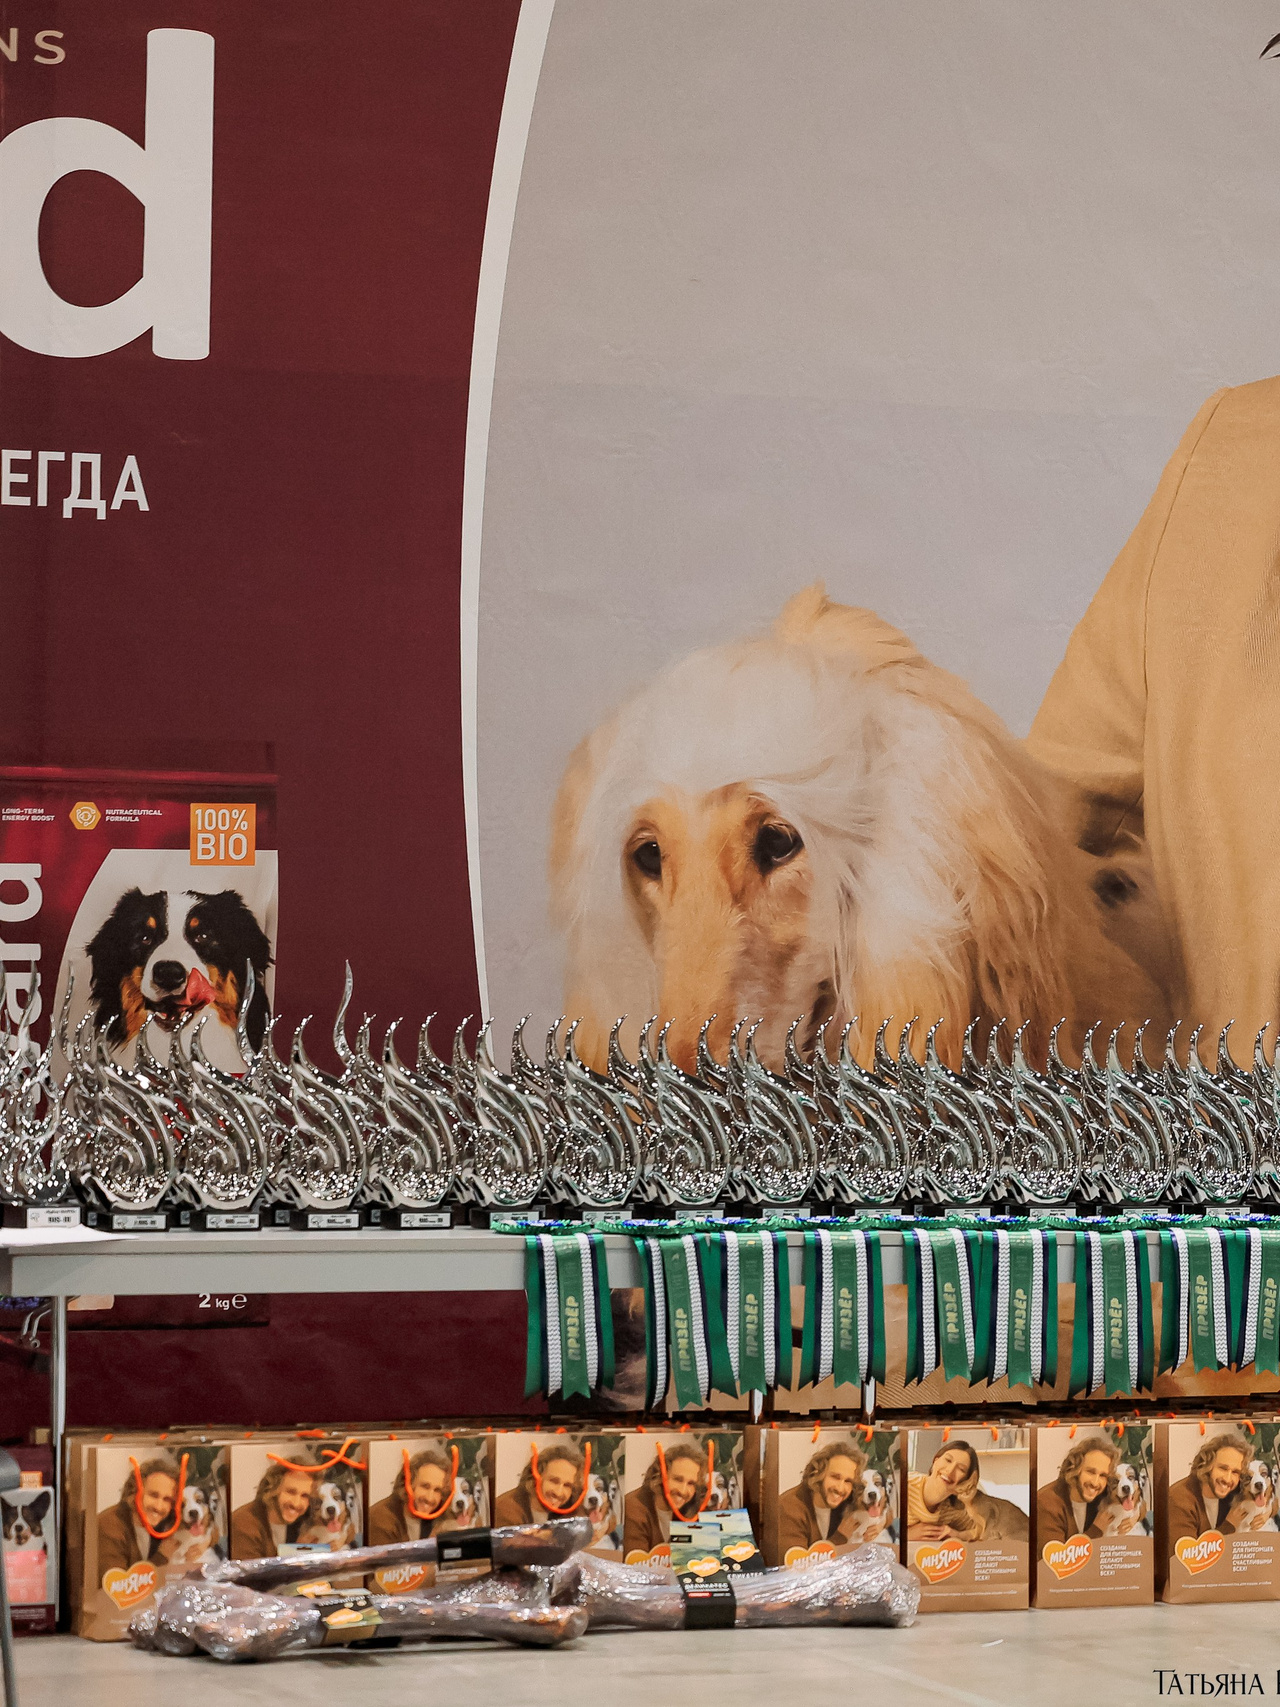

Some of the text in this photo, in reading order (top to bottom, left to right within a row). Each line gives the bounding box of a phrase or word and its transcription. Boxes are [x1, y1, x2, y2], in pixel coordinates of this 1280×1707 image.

[1, 449, 150, 521] ЕГДА
[2, 814, 55, 822] ENERGY BOOST
[195, 808, 248, 831] 100%
[196, 833, 248, 861] BIO
[215, 1298, 230, 1311] kg
[921, 1547, 964, 1569] МНЯМС
[1050, 1543, 1090, 1565] МНЯМС
[1182, 1539, 1222, 1561] МНЯМС
